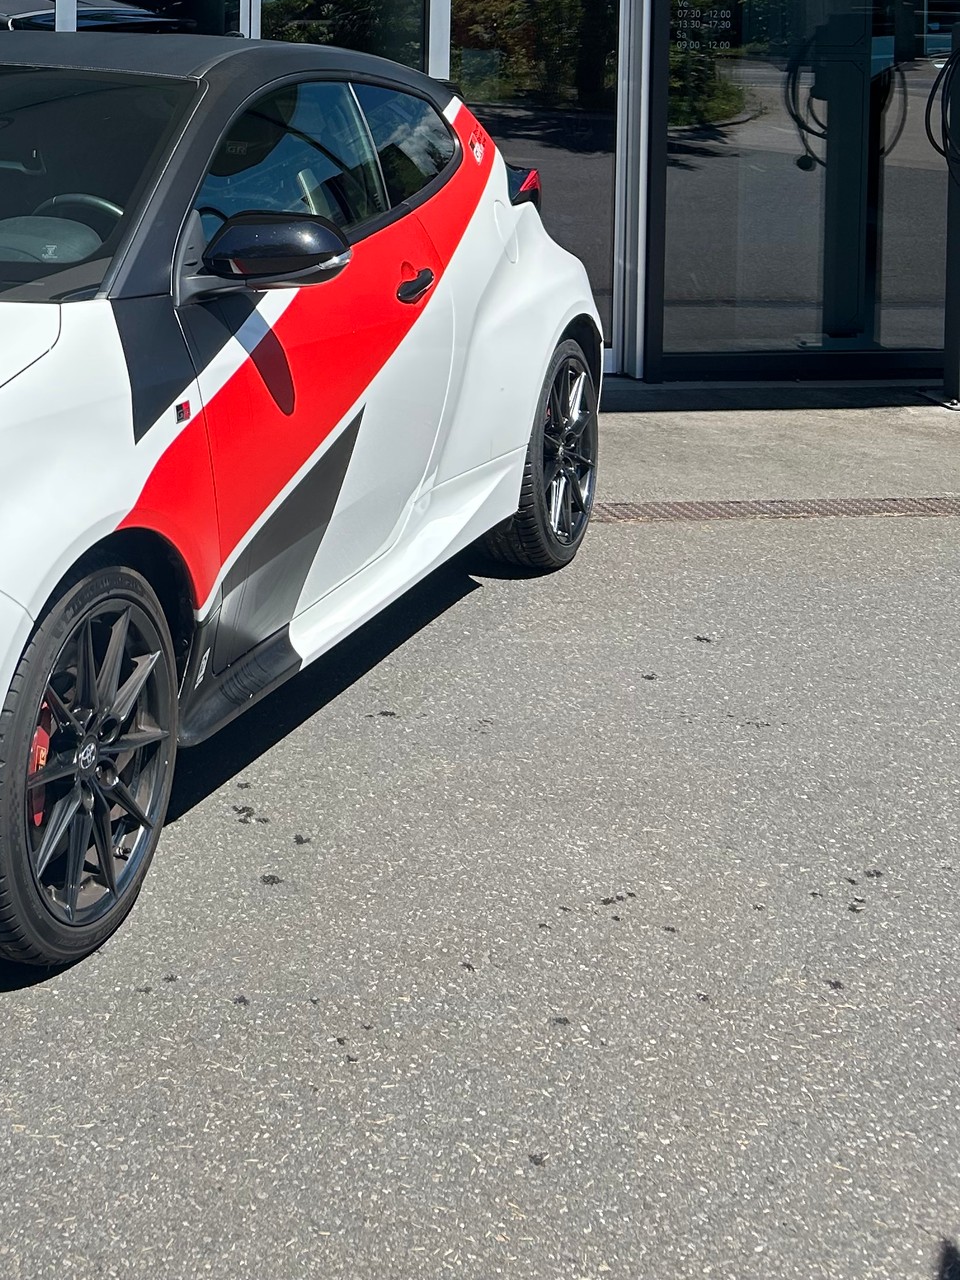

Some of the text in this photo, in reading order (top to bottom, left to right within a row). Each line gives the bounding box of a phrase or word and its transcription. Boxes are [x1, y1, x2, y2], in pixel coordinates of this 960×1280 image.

[709, 10, 731, 18] 12:00
[676, 30, 687, 39] Sa
[708, 41, 730, 49] 12:00
